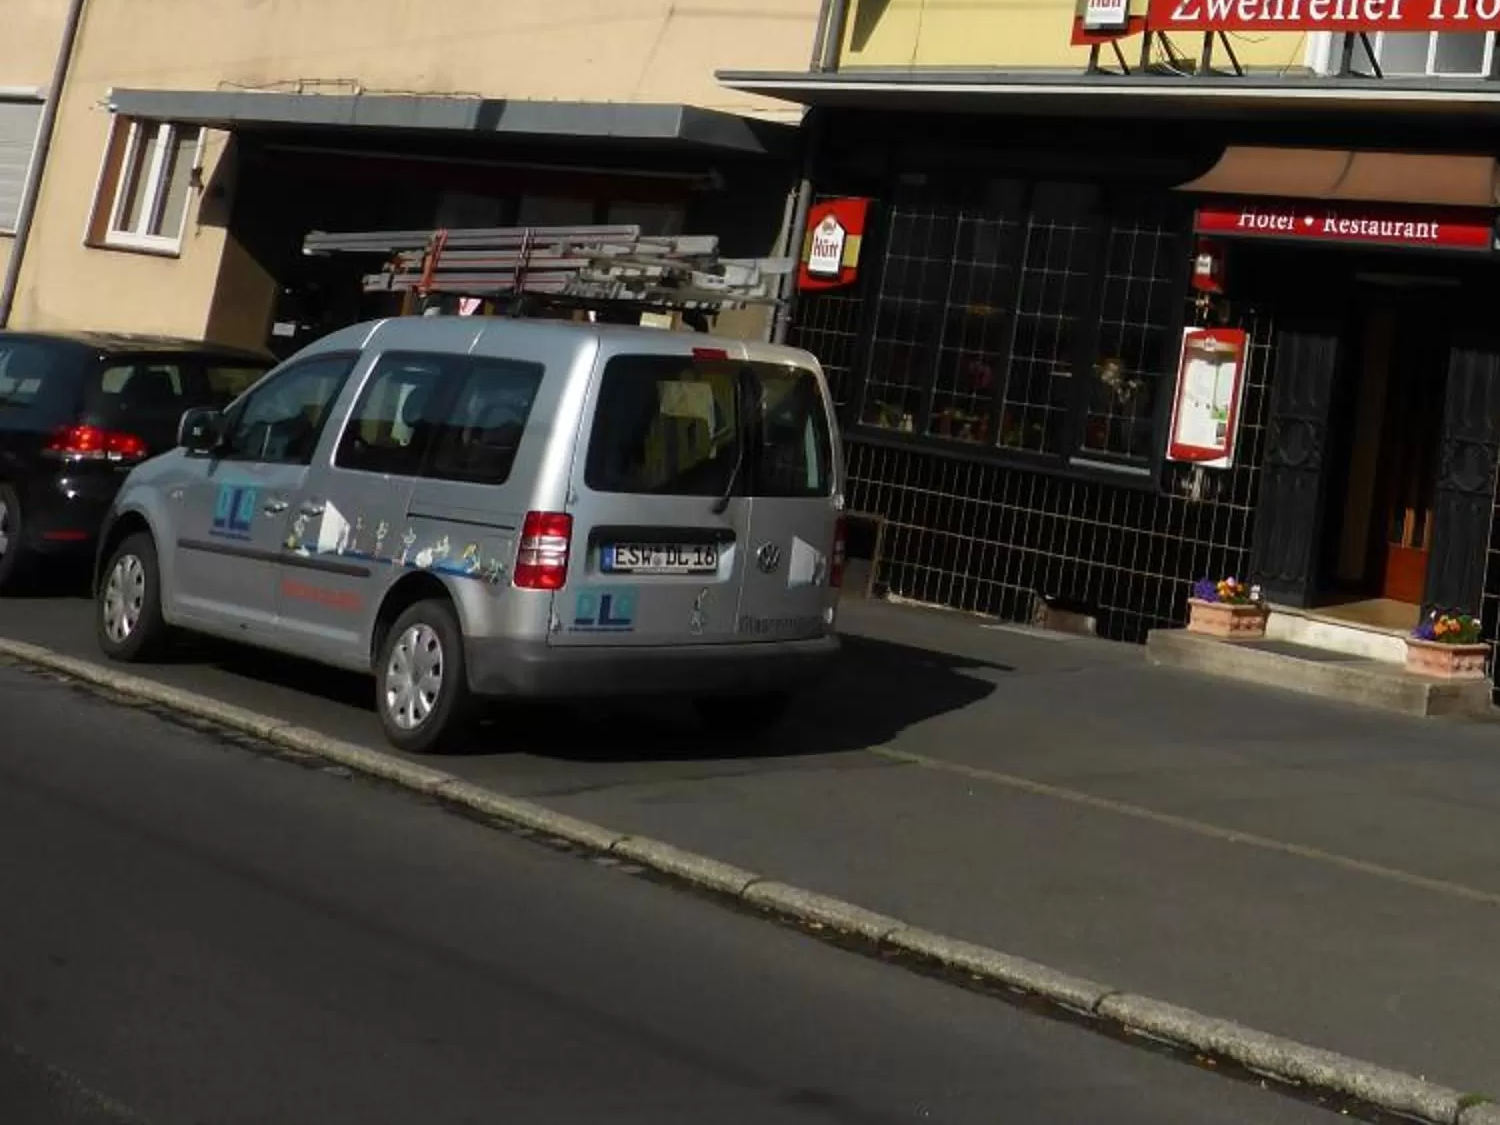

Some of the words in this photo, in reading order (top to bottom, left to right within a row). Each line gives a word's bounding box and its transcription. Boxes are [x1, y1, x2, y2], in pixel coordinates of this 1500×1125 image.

[1237, 207, 1296, 231] Hotel
[1322, 209, 1440, 239] Restaurant
[615, 544, 652, 566] ESW
[666, 544, 689, 566] DL
[694, 546, 716, 566] 16
